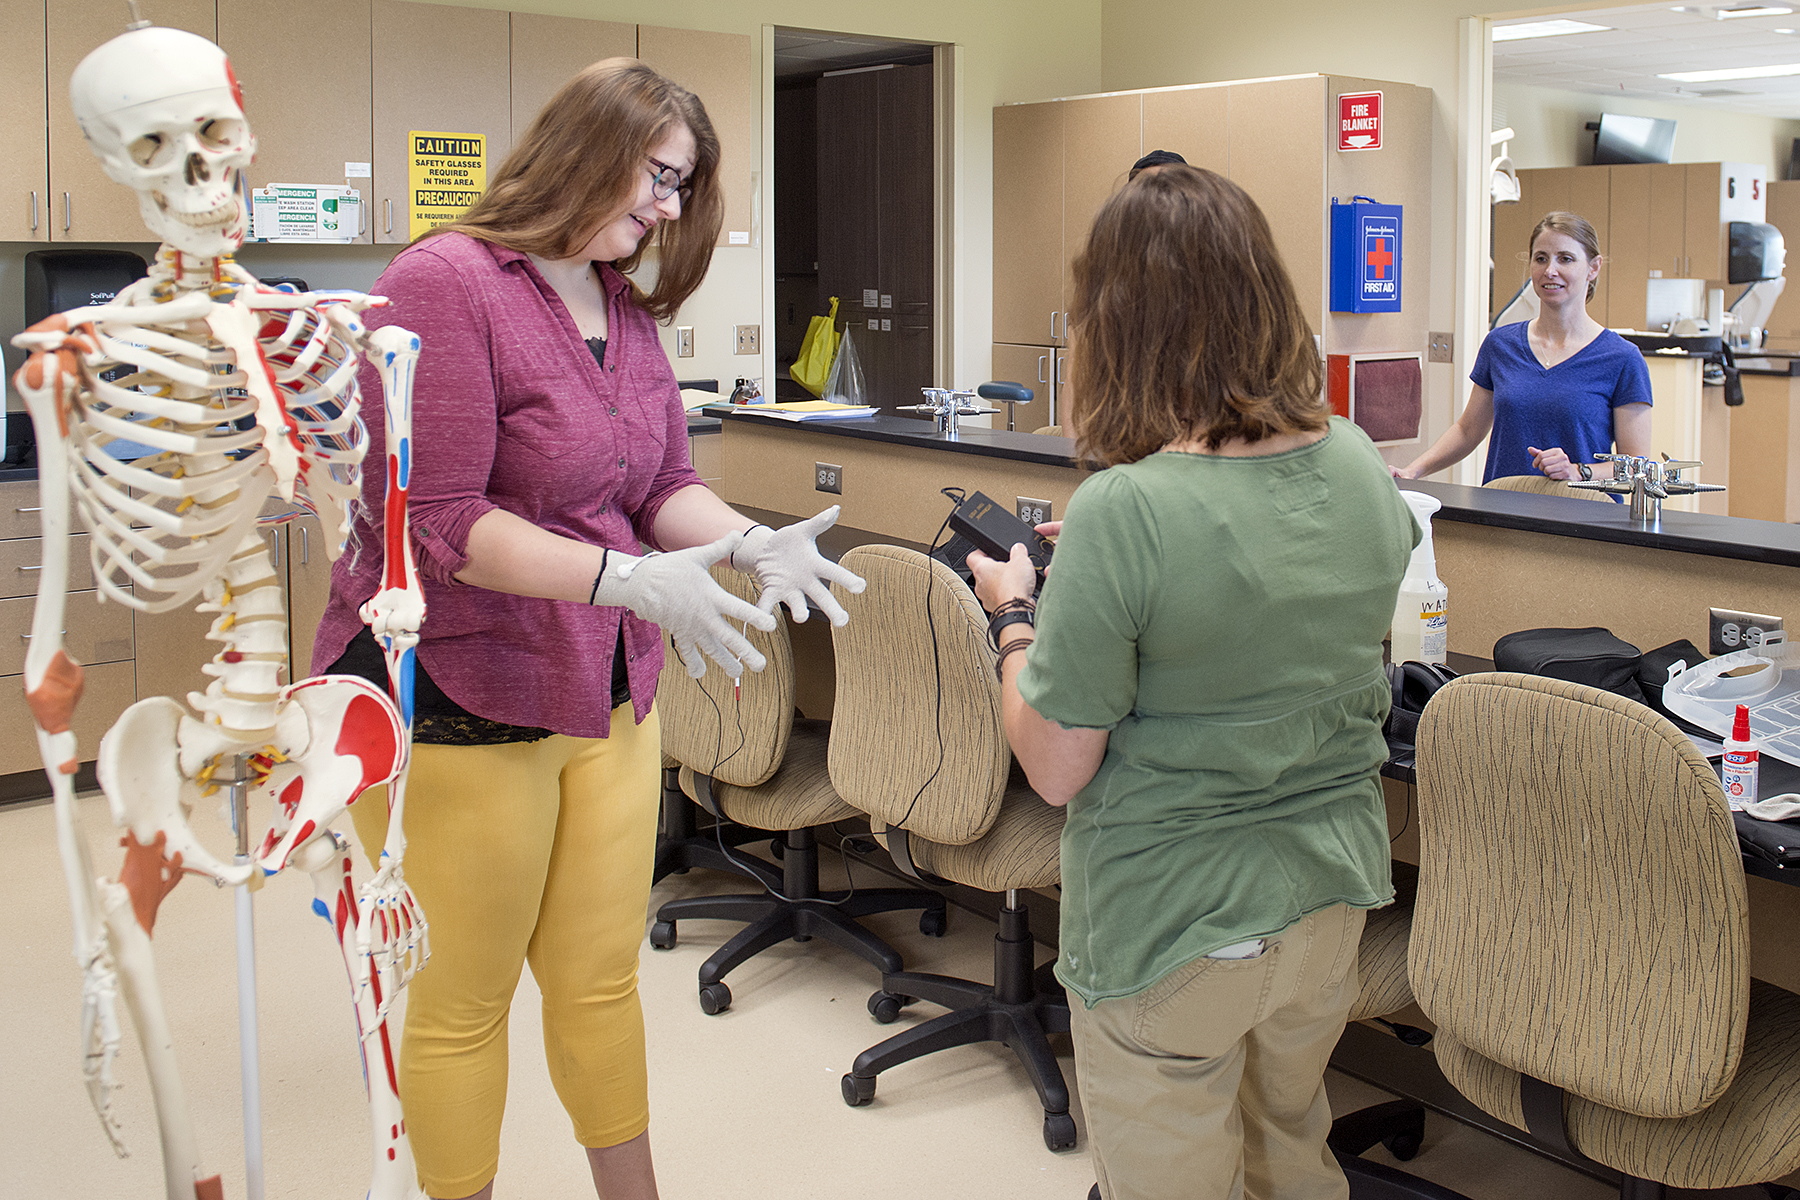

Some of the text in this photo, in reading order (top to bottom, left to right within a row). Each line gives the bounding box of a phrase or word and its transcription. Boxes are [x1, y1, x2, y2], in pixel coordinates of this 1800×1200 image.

[1351, 104, 1369, 117] FIRE
[1342, 117, 1378, 131] BLANKET
[416, 138, 480, 155] CAUTION
[415, 159, 482, 169] SAFETY GLASSES
[429, 169, 469, 177] REQUIRED
[423, 177, 432, 185] IN
[434, 178, 452, 186] THIS
[1728, 177, 1735, 198] 6
[1752, 179, 1759, 200] 5
[417, 191, 480, 206] PRECAUCION
[279, 213, 316, 221] MERGENCIA
[1364, 282, 1395, 293] FIRST AID
